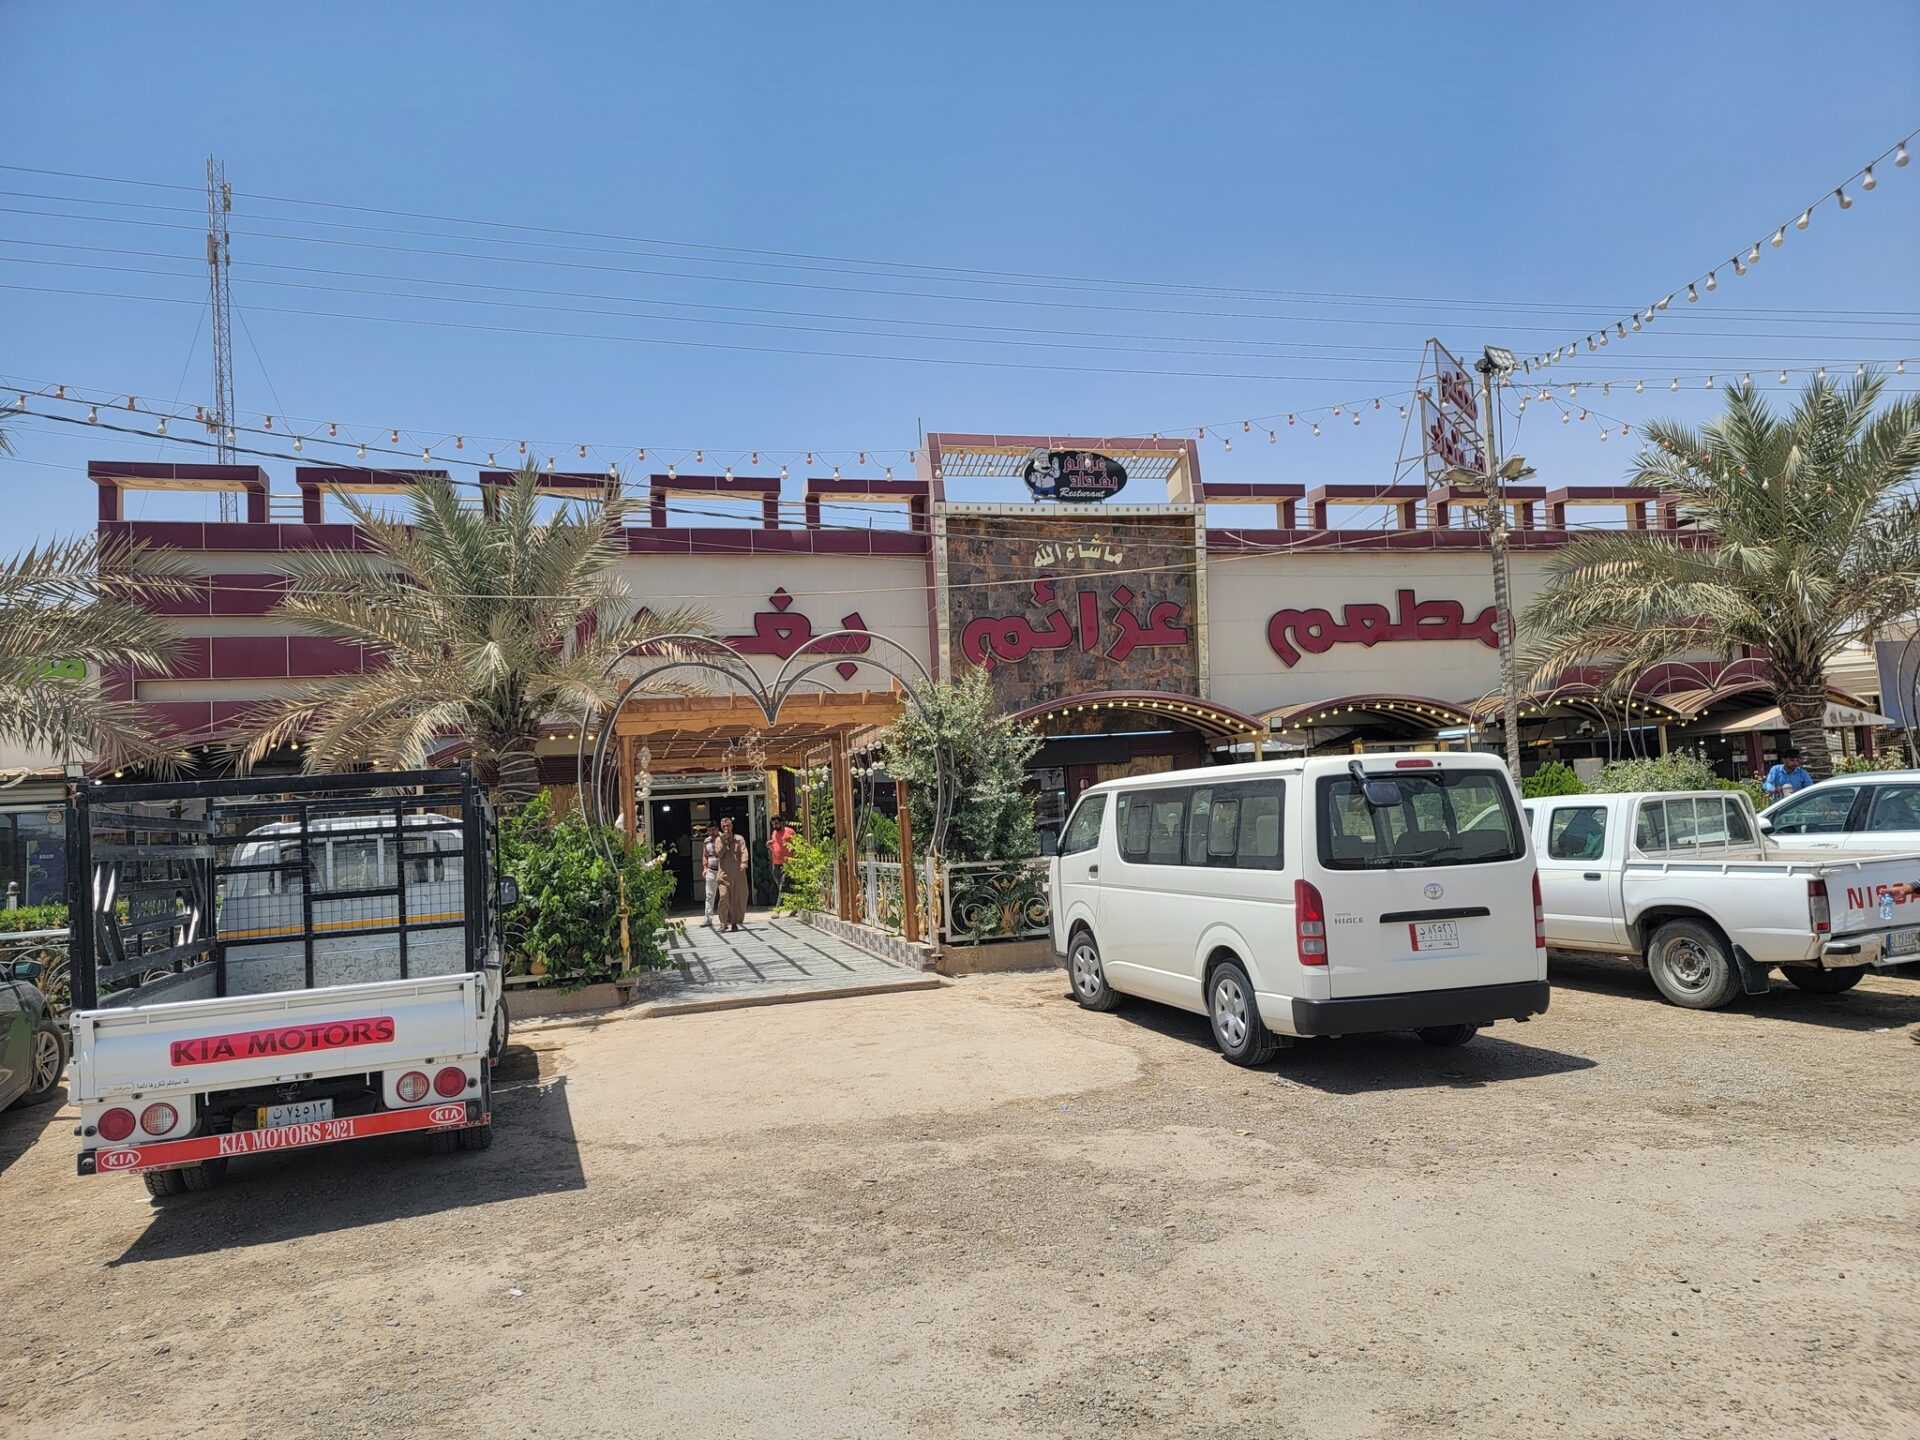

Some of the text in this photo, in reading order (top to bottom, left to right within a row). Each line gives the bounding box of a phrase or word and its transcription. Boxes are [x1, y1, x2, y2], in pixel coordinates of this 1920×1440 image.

[1062, 453, 1107, 474] عزائم
[1069, 471, 1119, 491] بغداد
[1059, 487, 1106, 498] Resturant
[1034, 543, 1062, 567] الله
[961, 574, 1189, 674] عزائم
[1267, 589, 1515, 669] مطعم
[1334, 917, 1365, 925] HIACE
[174, 1019, 394, 1063] KIA MOTORS
[435, 1108, 459, 1121] KIA
[218, 1132, 249, 1155] KIA
[252, 1123, 322, 1151] MOTORS
[324, 1119, 356, 1140] 2021
[108, 1152, 136, 1166] KIA
